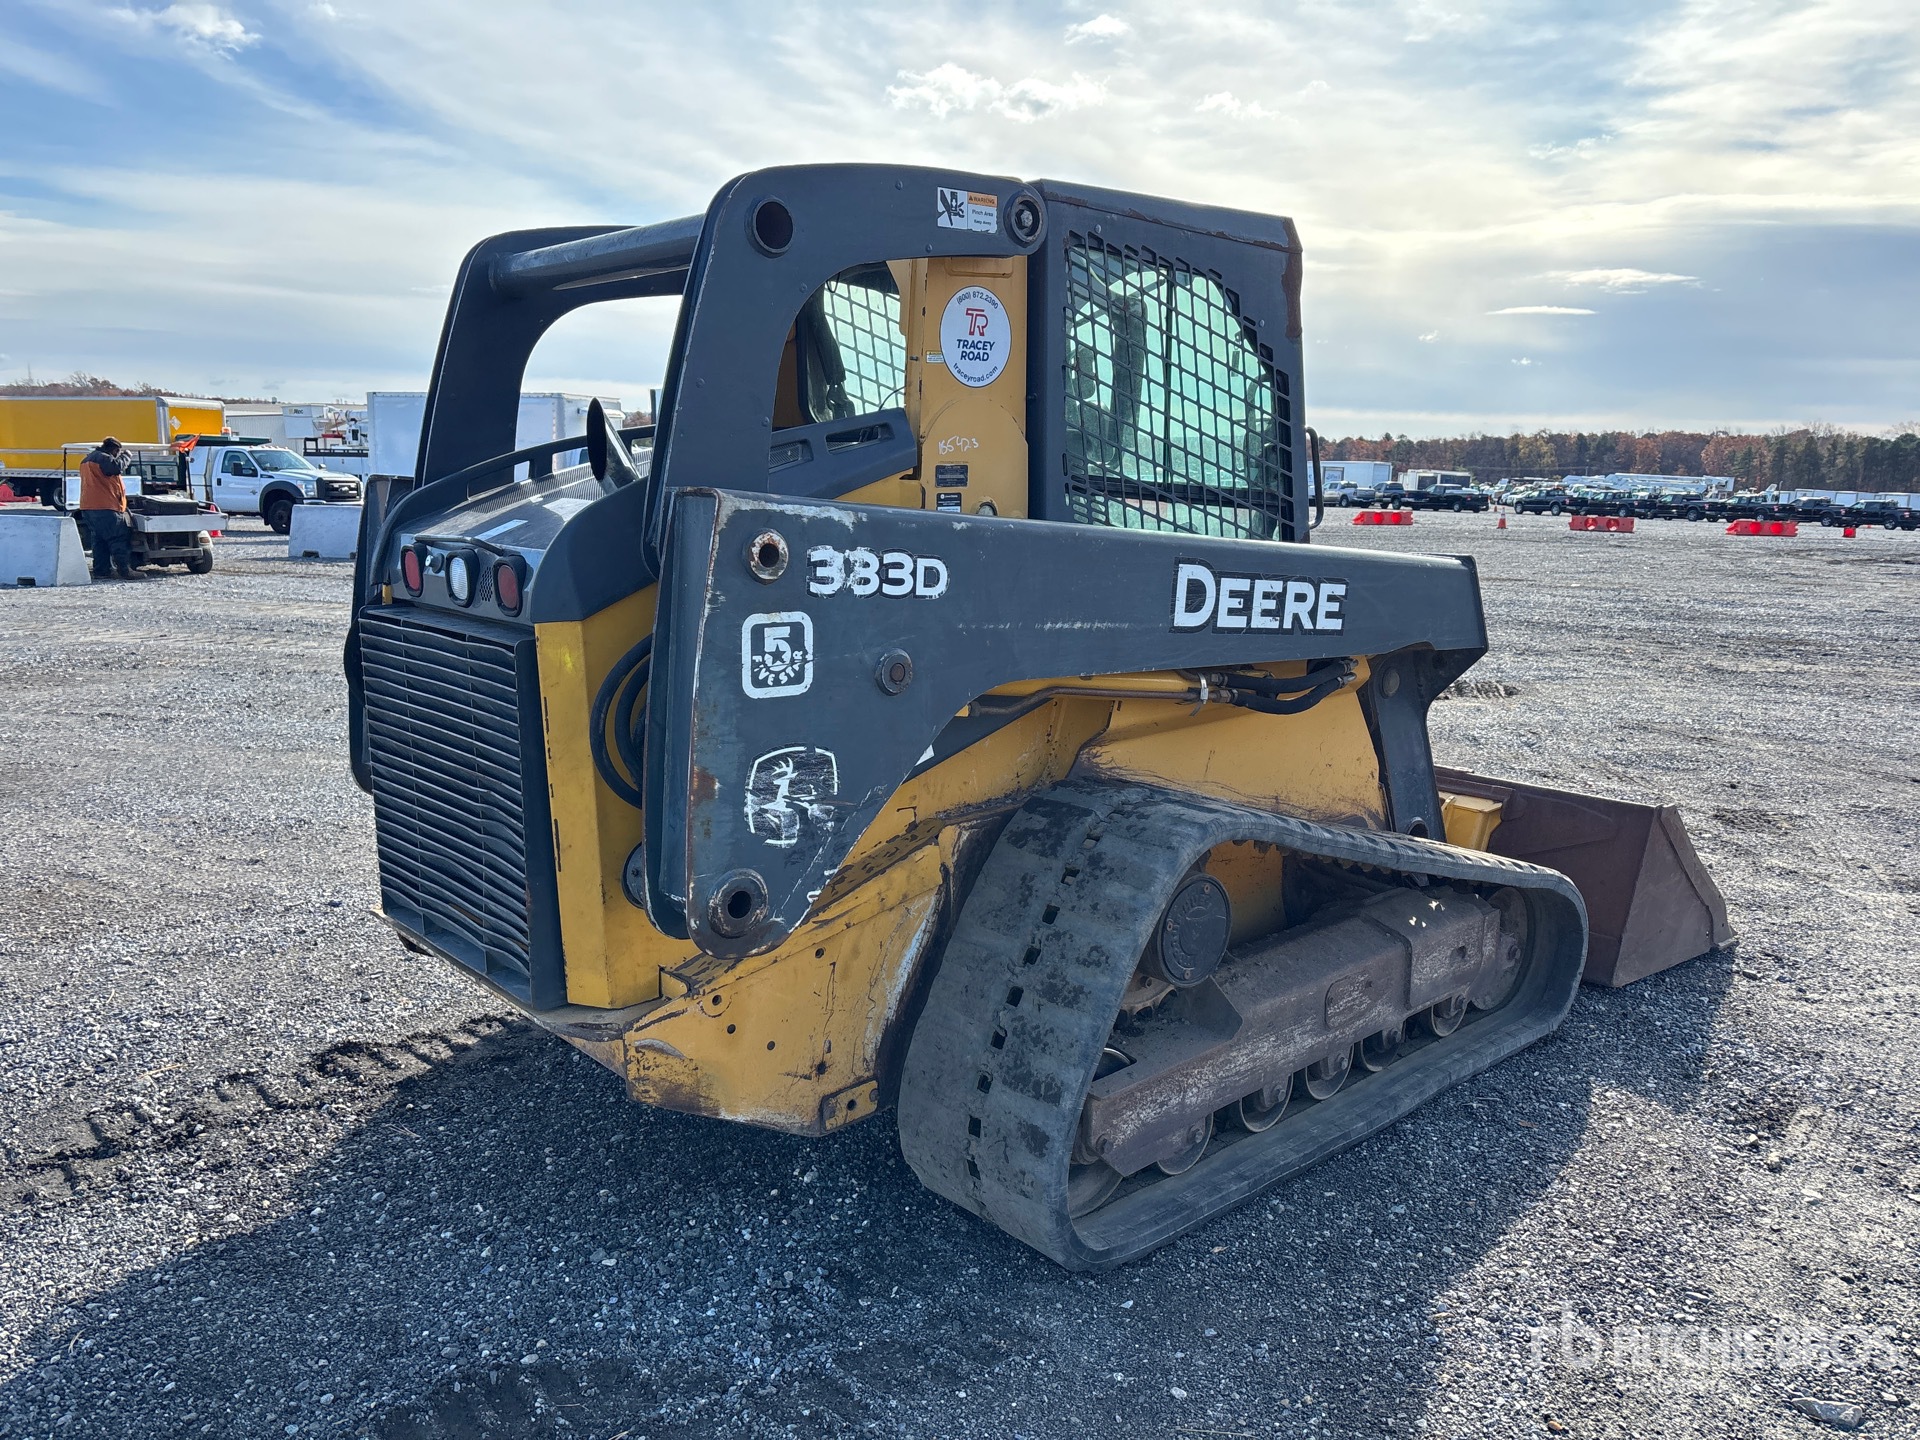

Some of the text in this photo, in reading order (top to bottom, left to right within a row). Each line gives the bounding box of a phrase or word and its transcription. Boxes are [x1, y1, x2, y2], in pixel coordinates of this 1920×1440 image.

[972, 291, 999, 310] 872.2390
[956, 338, 996, 351] TRACEY
[960, 350, 990, 362] ROAD
[953, 362, 999, 383] traceyroad.com
[808, 547, 949, 599] 383D
[1172, 563, 1347, 631] DEERE
[763, 626, 792, 671] 5
[752, 650, 803, 686] FIVE STAR
